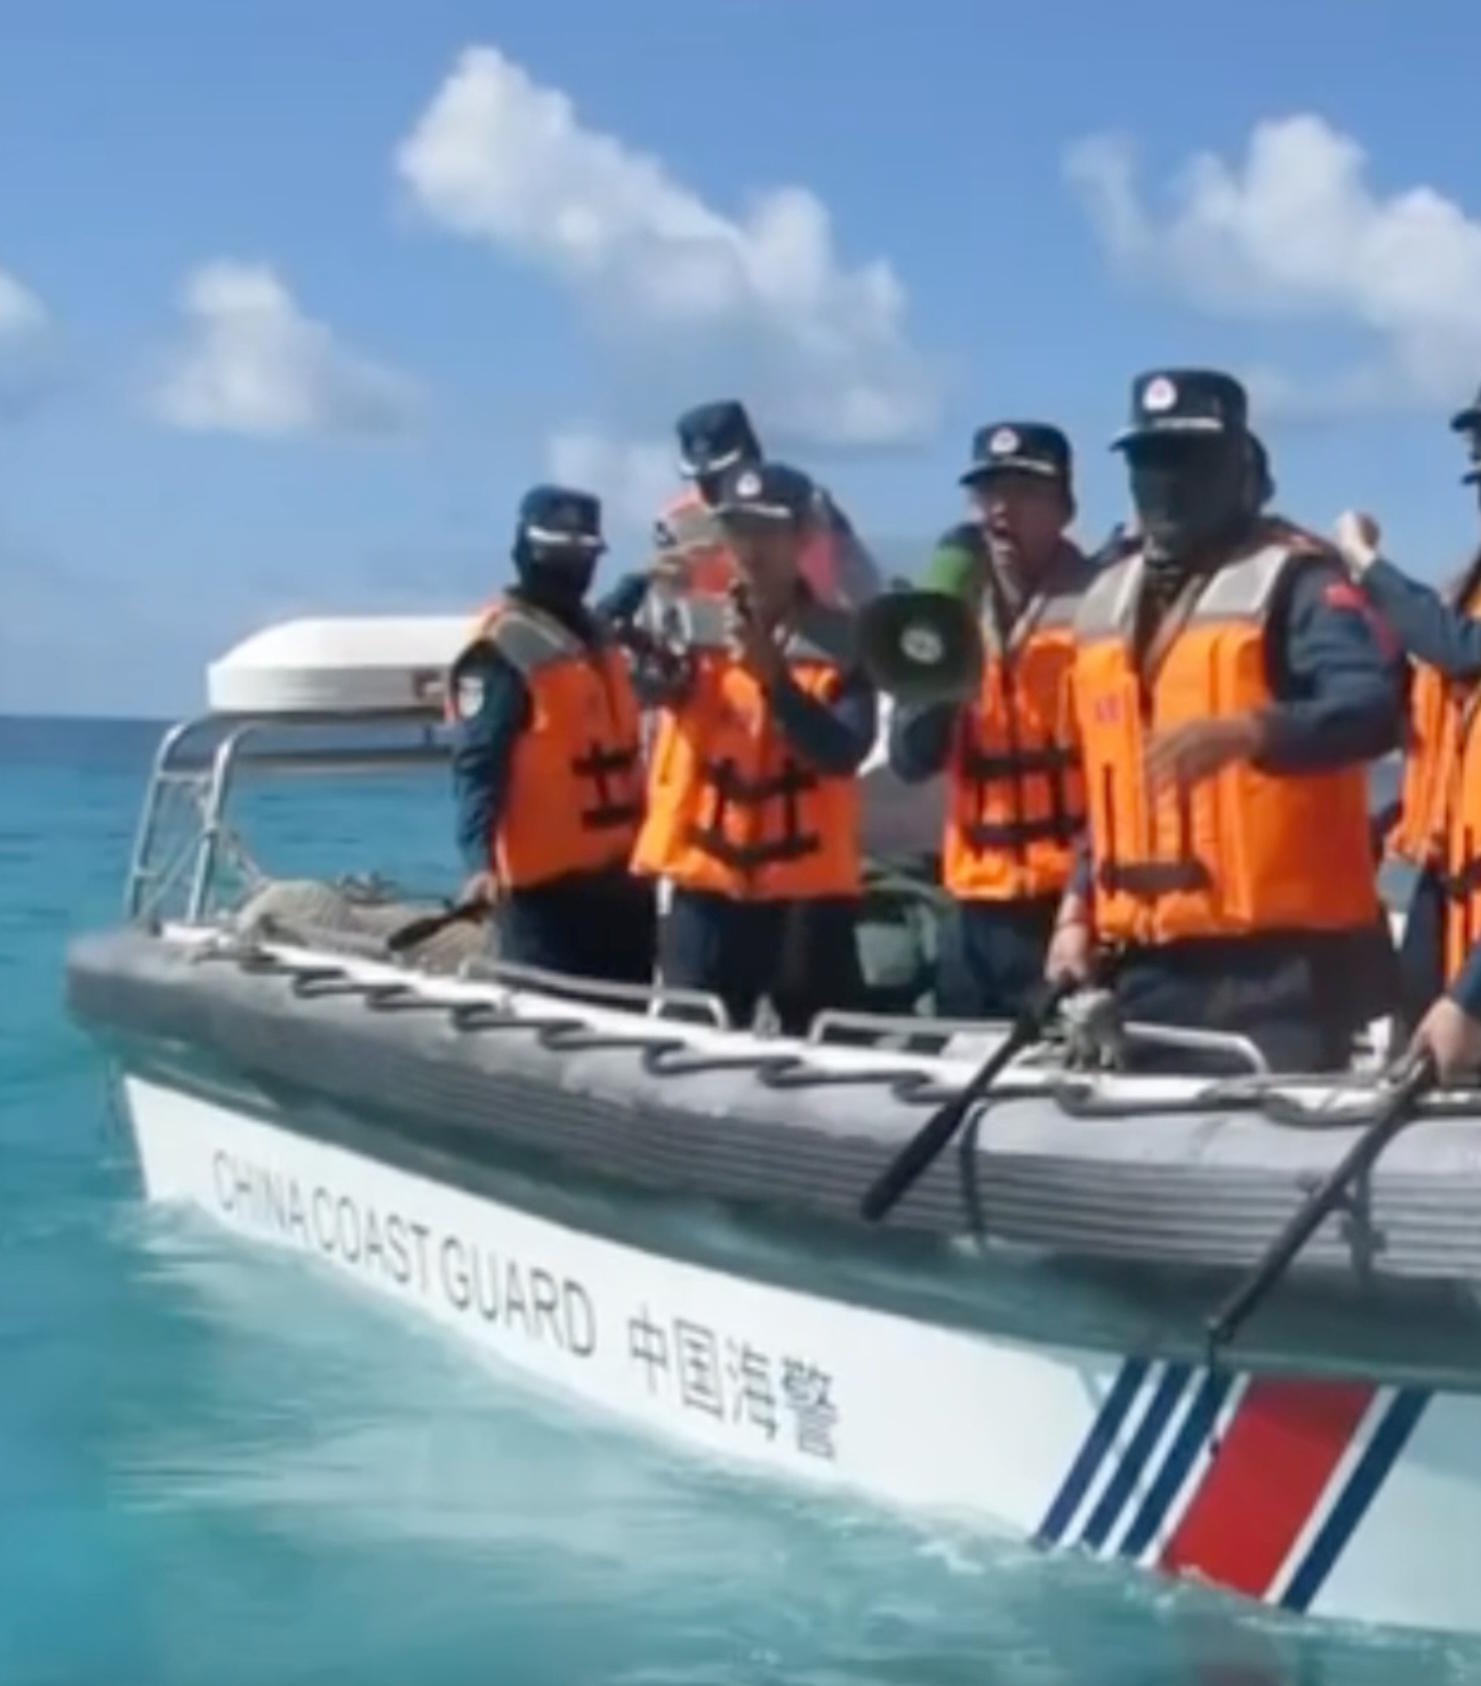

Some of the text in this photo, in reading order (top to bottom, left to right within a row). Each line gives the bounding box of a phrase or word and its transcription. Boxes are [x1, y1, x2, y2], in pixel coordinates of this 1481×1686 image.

[212, 1150, 597, 1358] CHINA COAST GUARD
[628, 1303, 838, 1461] 中国海警
